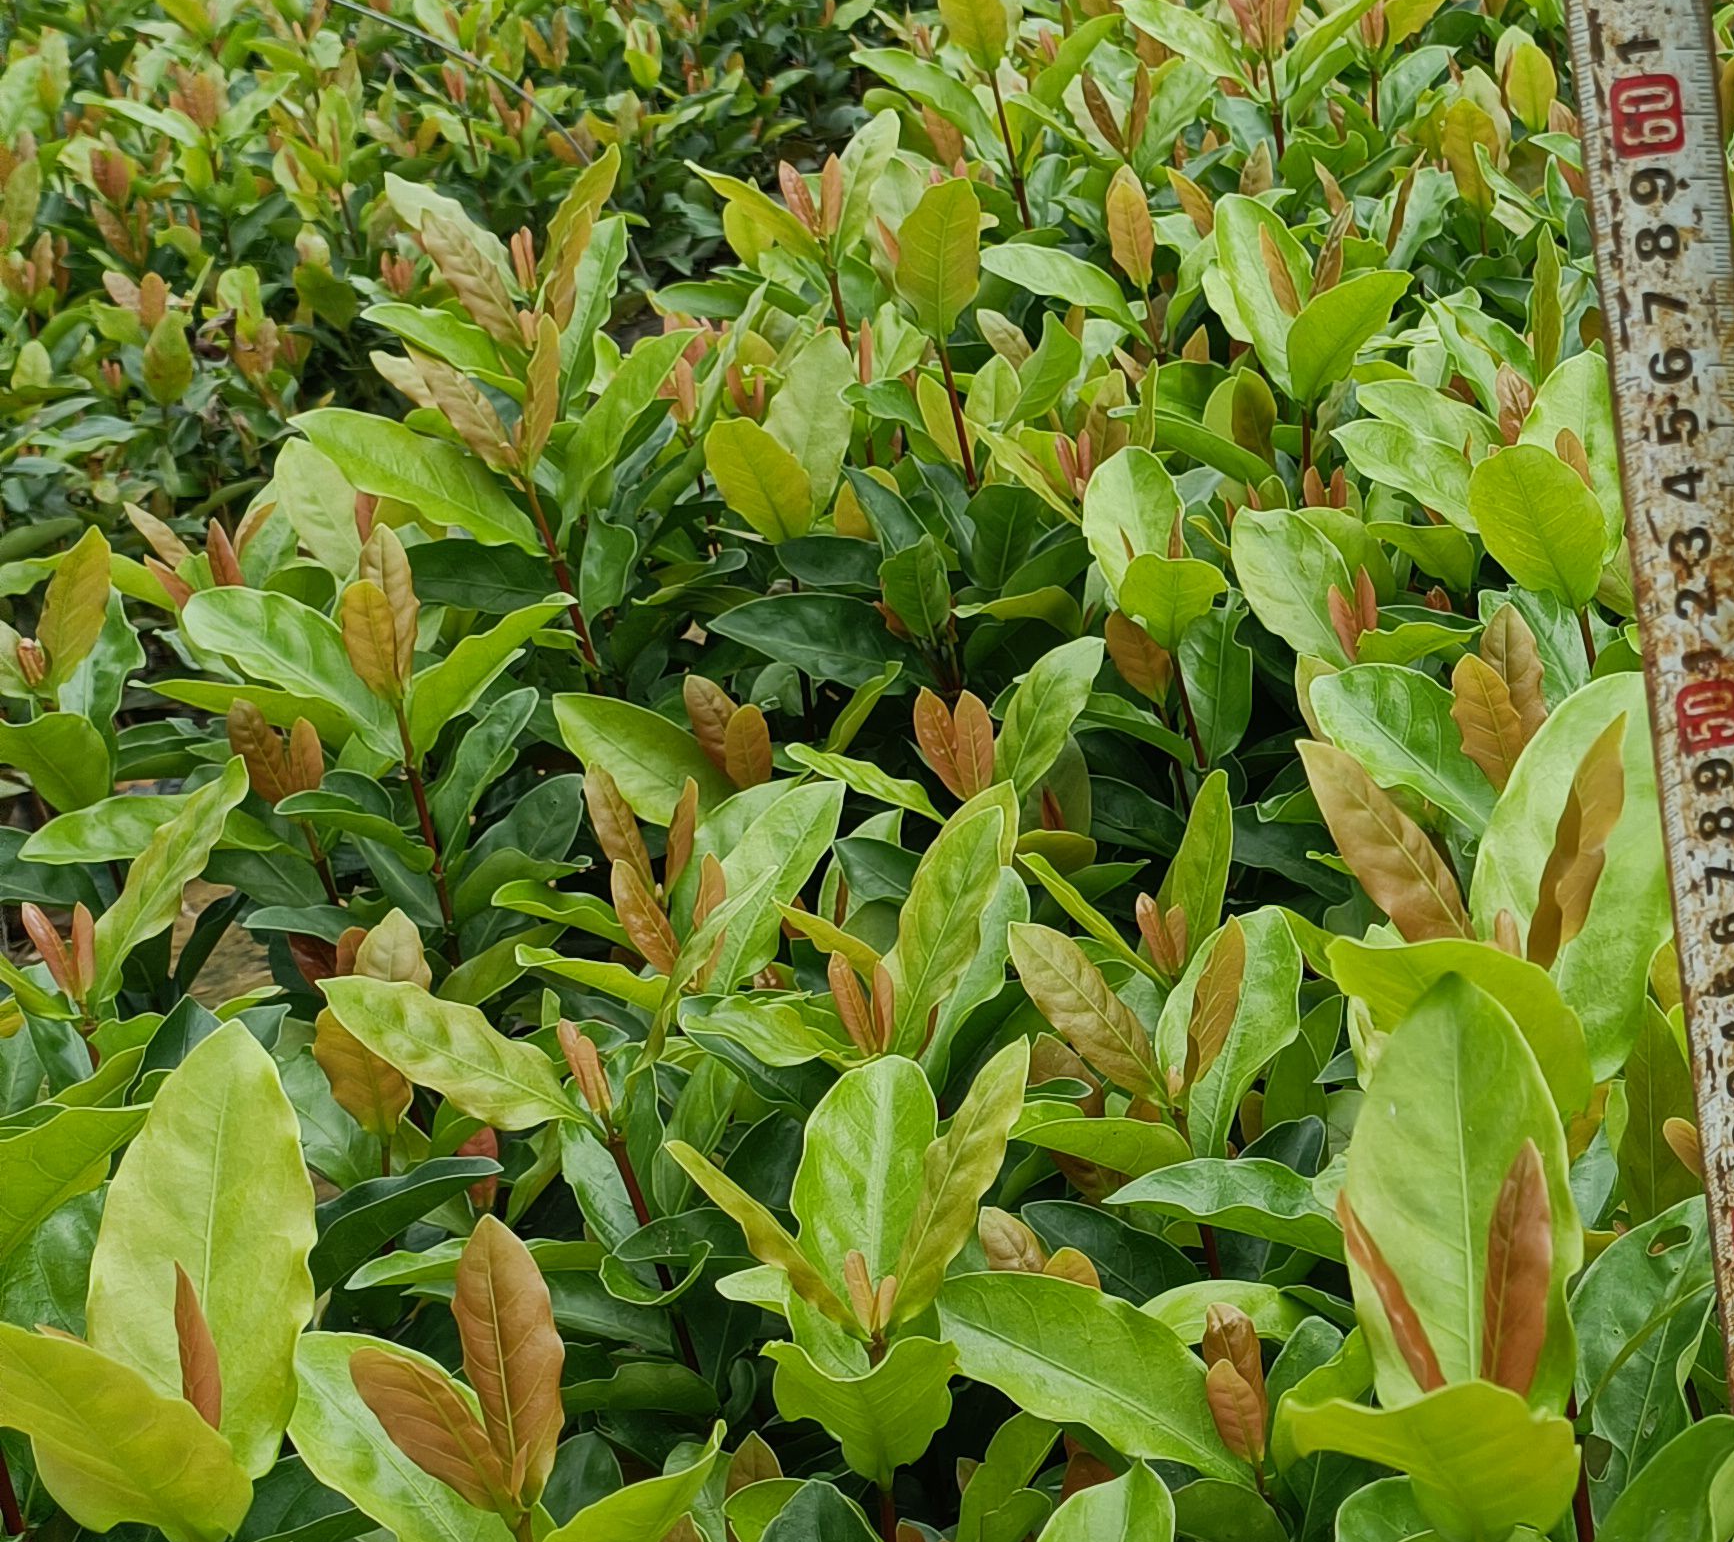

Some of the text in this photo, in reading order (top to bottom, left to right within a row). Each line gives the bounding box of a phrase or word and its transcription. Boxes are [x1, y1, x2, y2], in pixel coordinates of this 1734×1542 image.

[1616, 36, 1660, 64] 1
[1618, 85, 1678, 147] 60
[1629, 167, 1676, 206] 9
[1635, 223, 1681, 262] 8
[1642, 291, 1689, 325] 7
[1648, 346, 1694, 385] 6
[1655, 408, 1699, 447] 5
[1662, 466, 1705, 503] 4
[1668, 526, 1712, 563] 3
[1674, 581, 1718, 620] 2
[1692, 758, 1734, 794] 9
